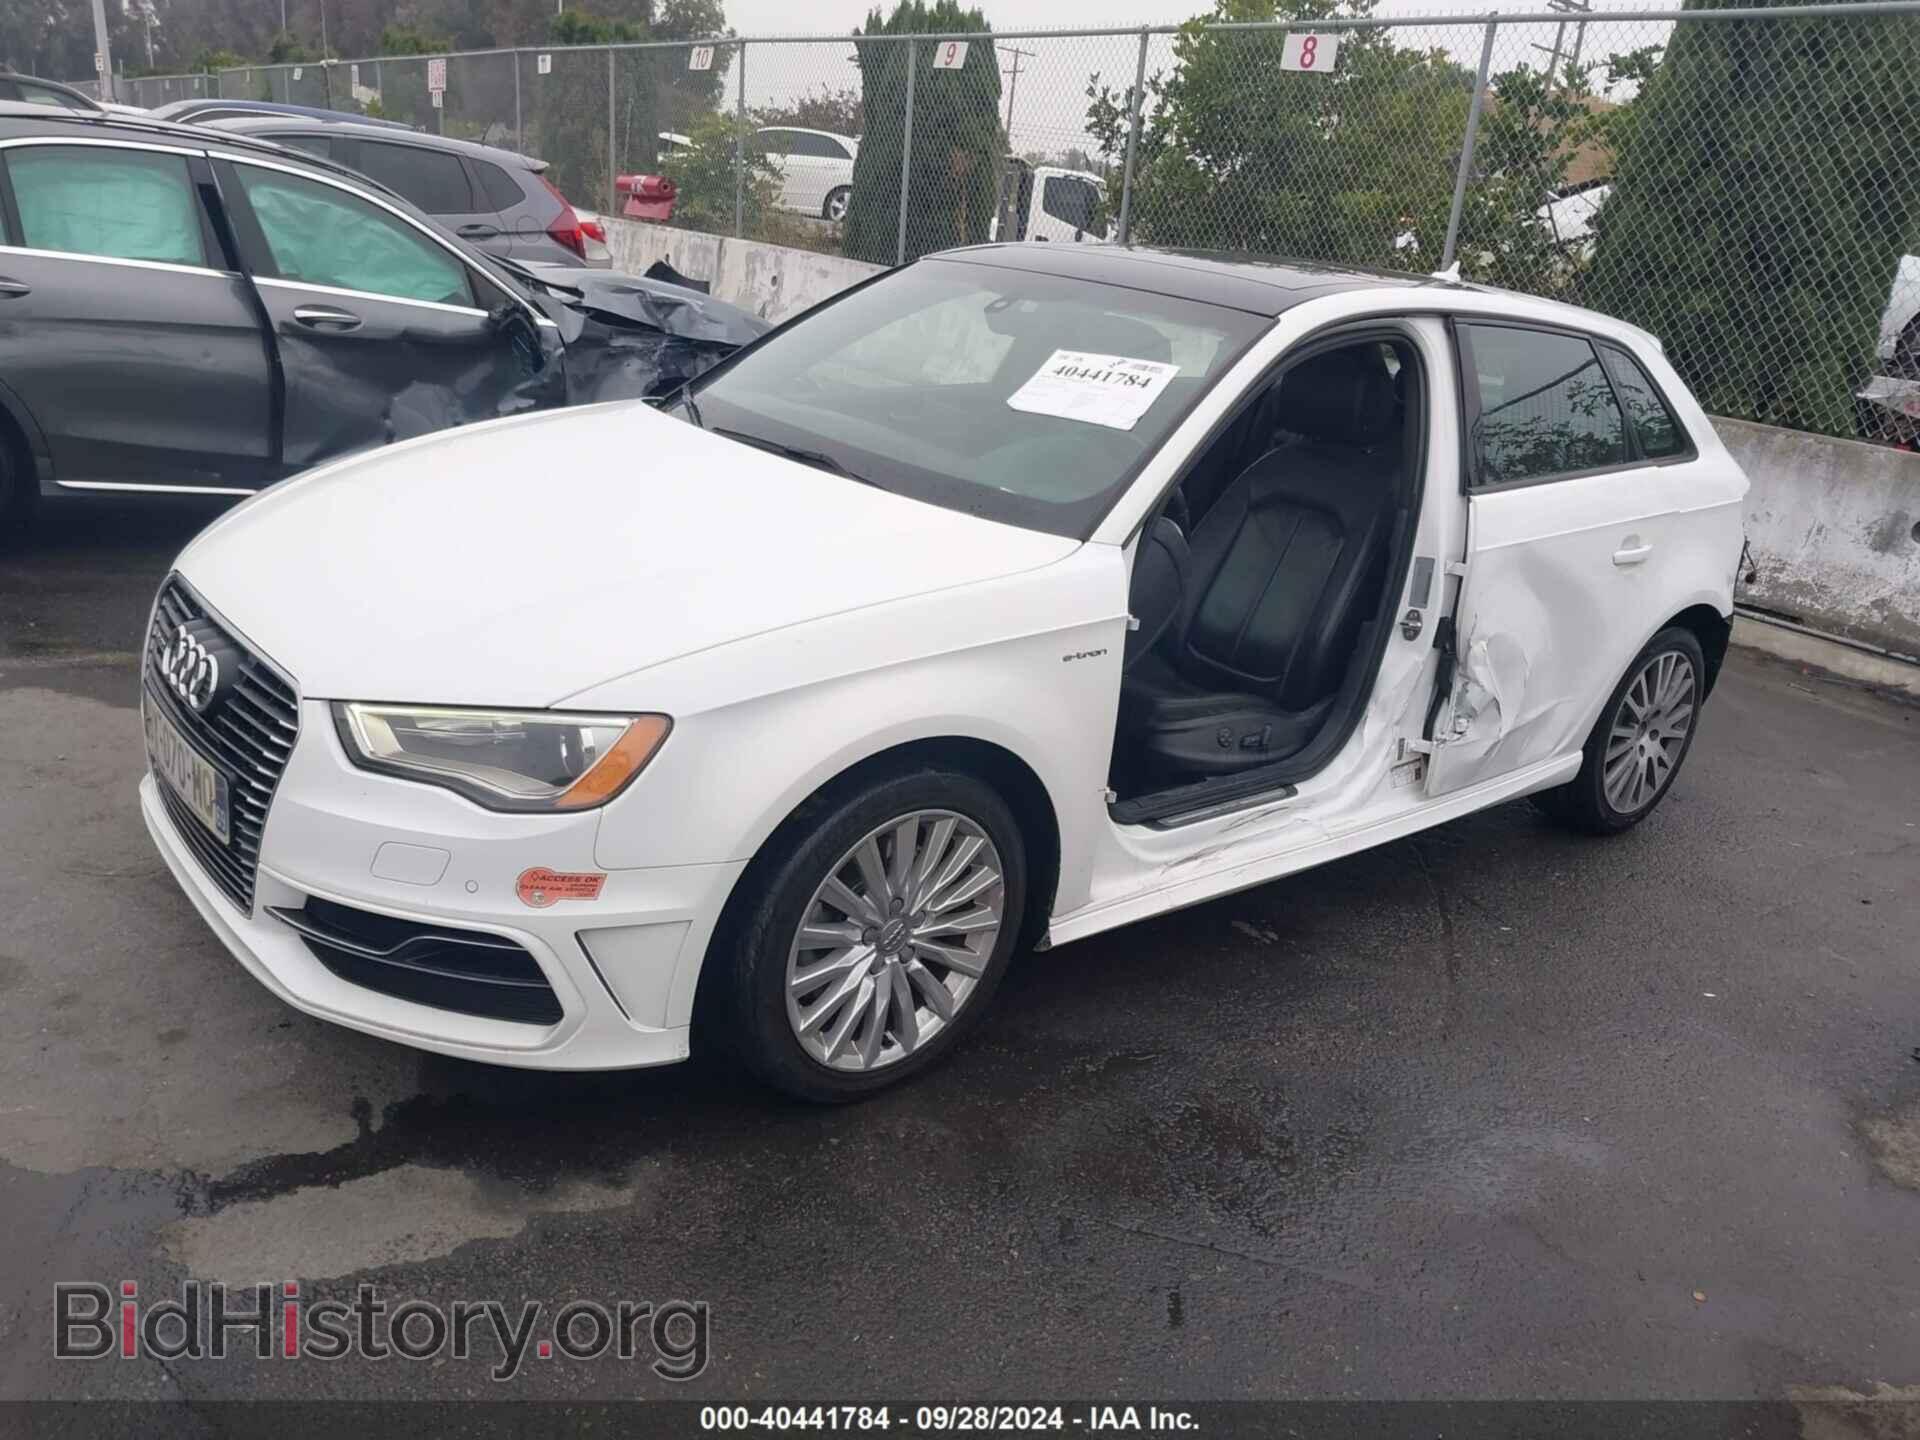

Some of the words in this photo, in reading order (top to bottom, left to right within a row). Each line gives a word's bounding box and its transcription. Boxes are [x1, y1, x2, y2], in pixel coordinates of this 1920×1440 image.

[696, 49, 709, 68] 10
[945, 43, 956, 66] 9
[1300, 36, 1318, 69] 8
[1053, 365, 1153, 388] 40441784
[1062, 649, 1107, 662] e-tron
